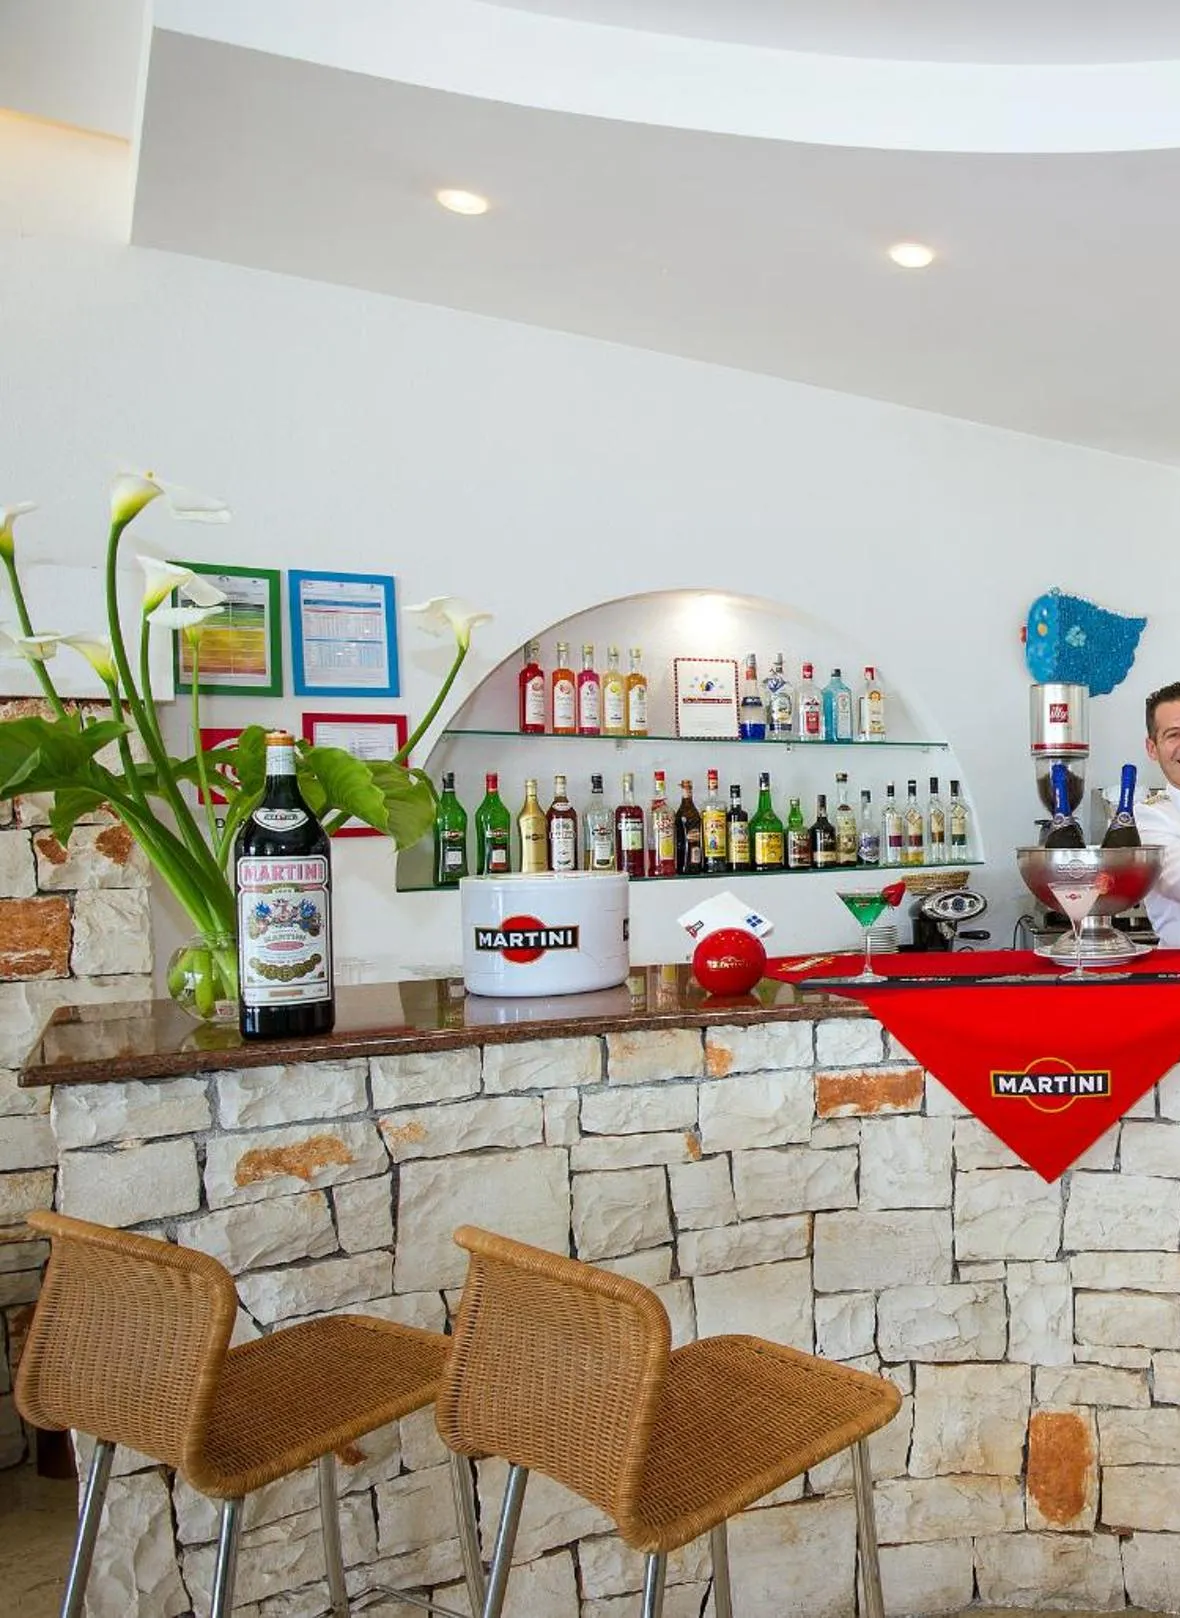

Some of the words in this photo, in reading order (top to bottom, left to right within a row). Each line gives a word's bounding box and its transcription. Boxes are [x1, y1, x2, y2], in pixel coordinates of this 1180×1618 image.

[241, 864, 323, 882] MARTINI
[478, 929, 573, 947] MARTINI
[998, 1075, 1103, 1093] MARTINI
